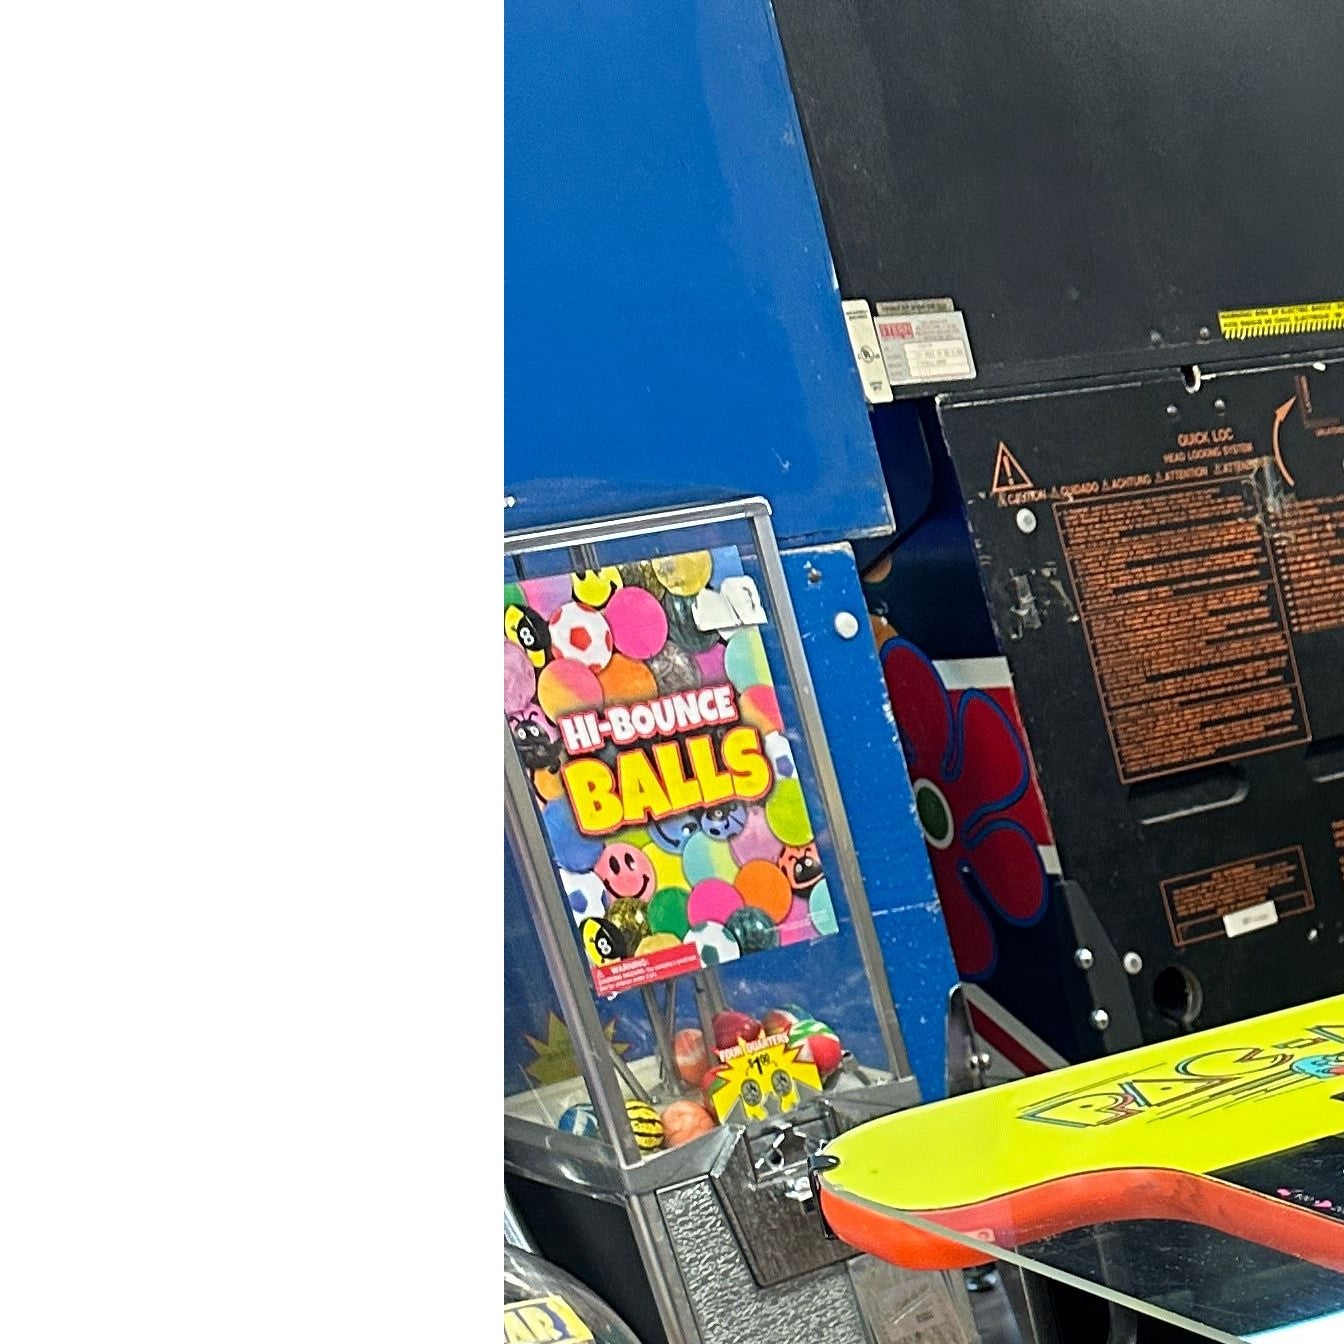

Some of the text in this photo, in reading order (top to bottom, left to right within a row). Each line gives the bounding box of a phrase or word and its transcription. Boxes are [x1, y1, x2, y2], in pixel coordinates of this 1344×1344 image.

[1177, 427, 1235, 447] QUICK LOC
[562, 686, 737, 753] HI-BOUNCE
[563, 729, 772, 835] BALLS
